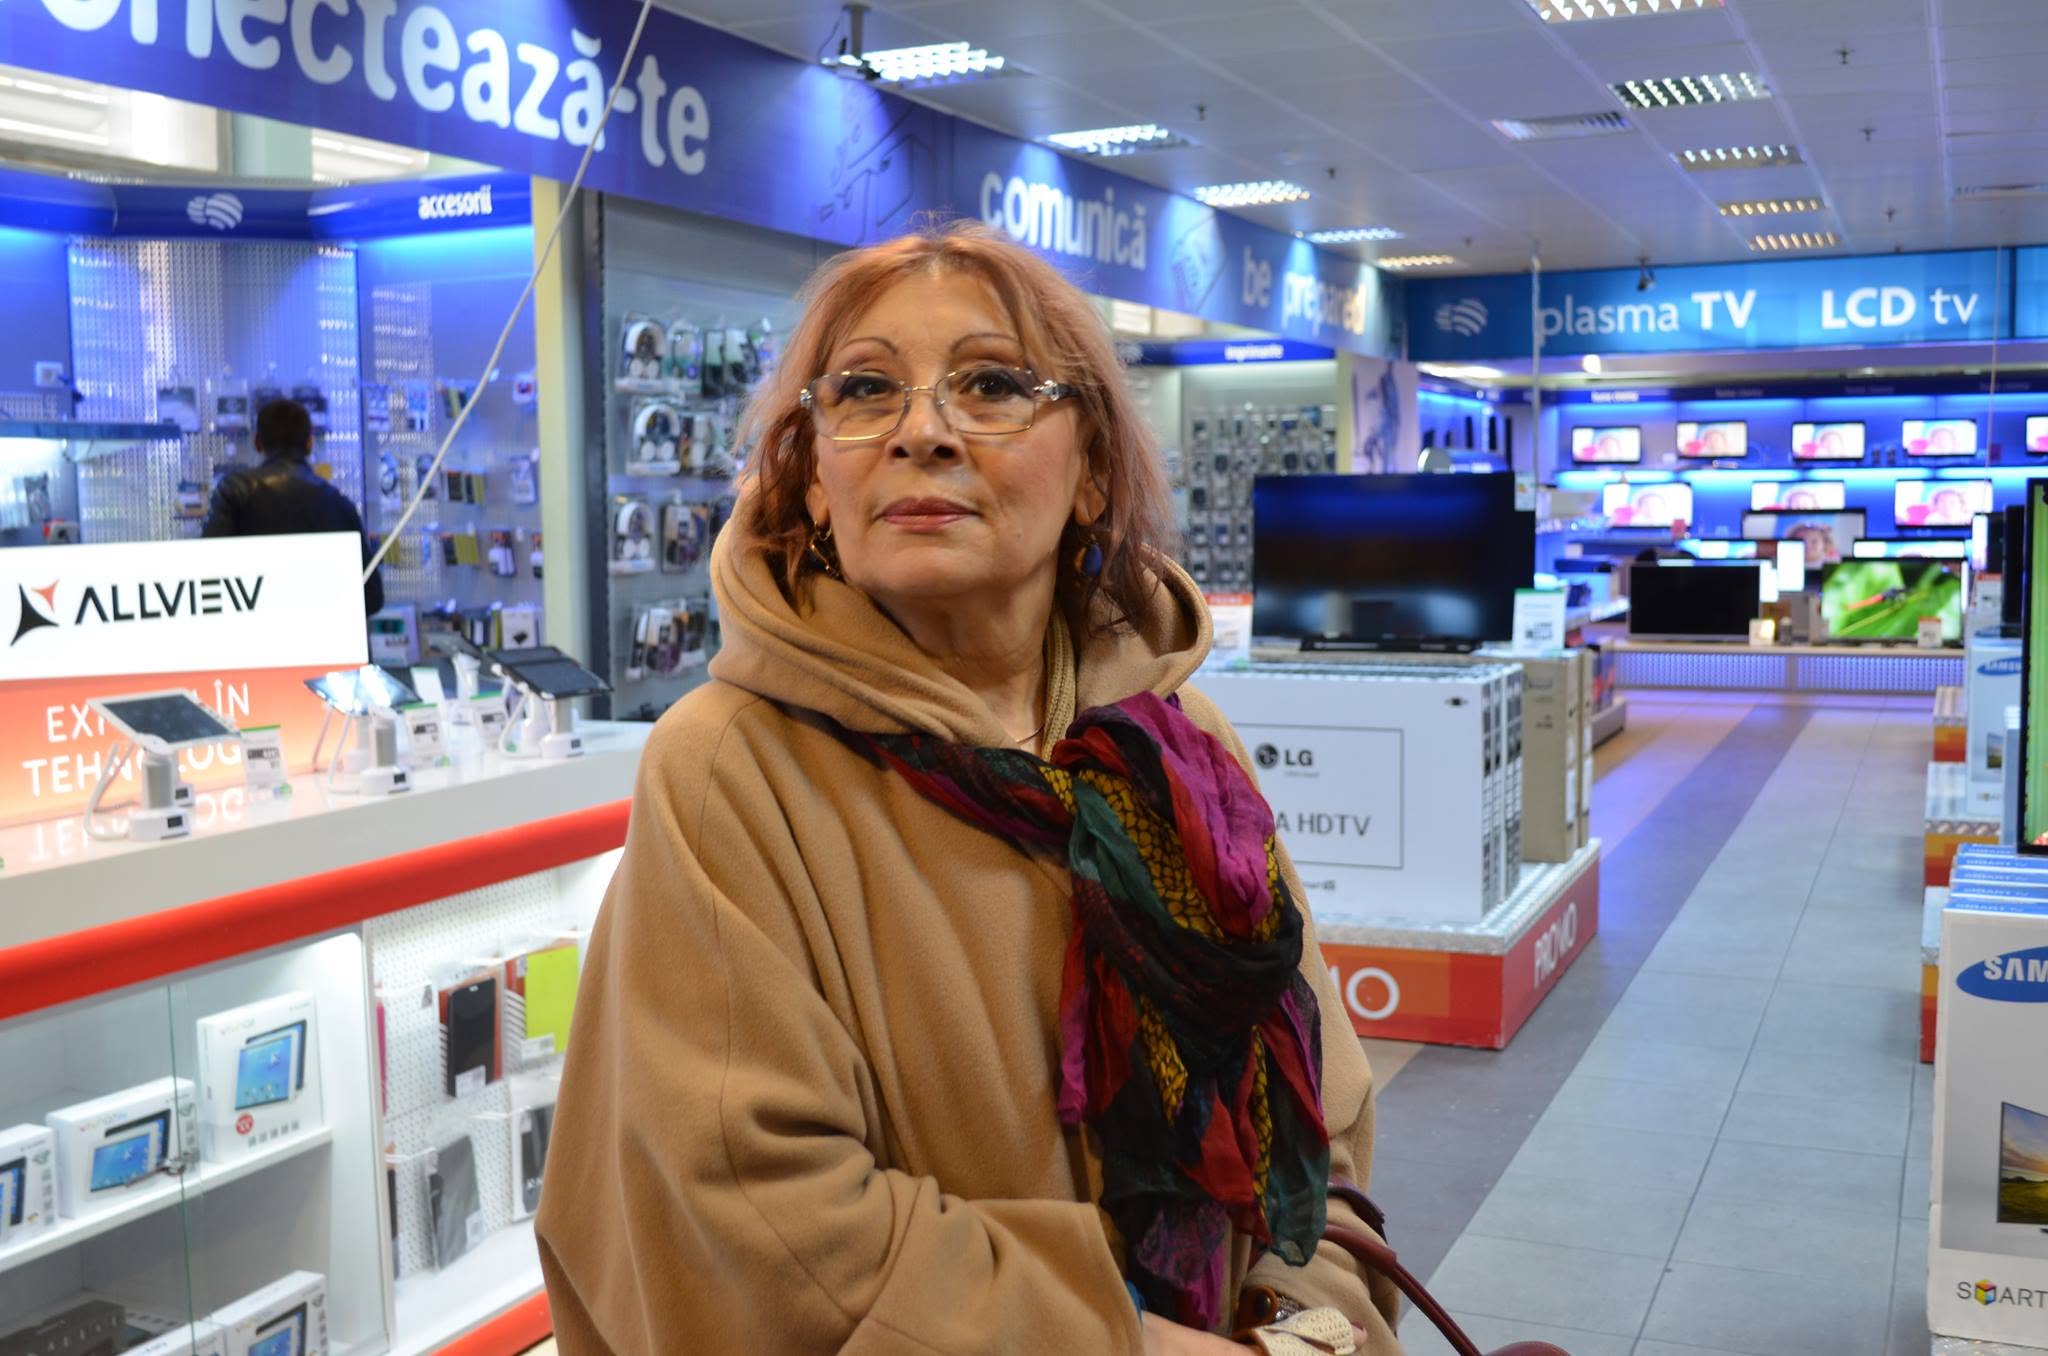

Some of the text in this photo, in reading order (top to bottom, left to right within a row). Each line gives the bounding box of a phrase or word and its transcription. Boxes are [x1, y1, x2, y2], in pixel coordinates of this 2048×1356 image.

[418, 185, 493, 220] accesorii
[980, 171, 1147, 271] comunică
[1243, 246, 1271, 308] be
[1536, 289, 1756, 347] plasma TV
[1821, 287, 1979, 330] LCD tv
[75, 575, 263, 625] ALLVIEW
[1285, 749, 1313, 766] LG
[1298, 813, 1371, 836] HDTV
